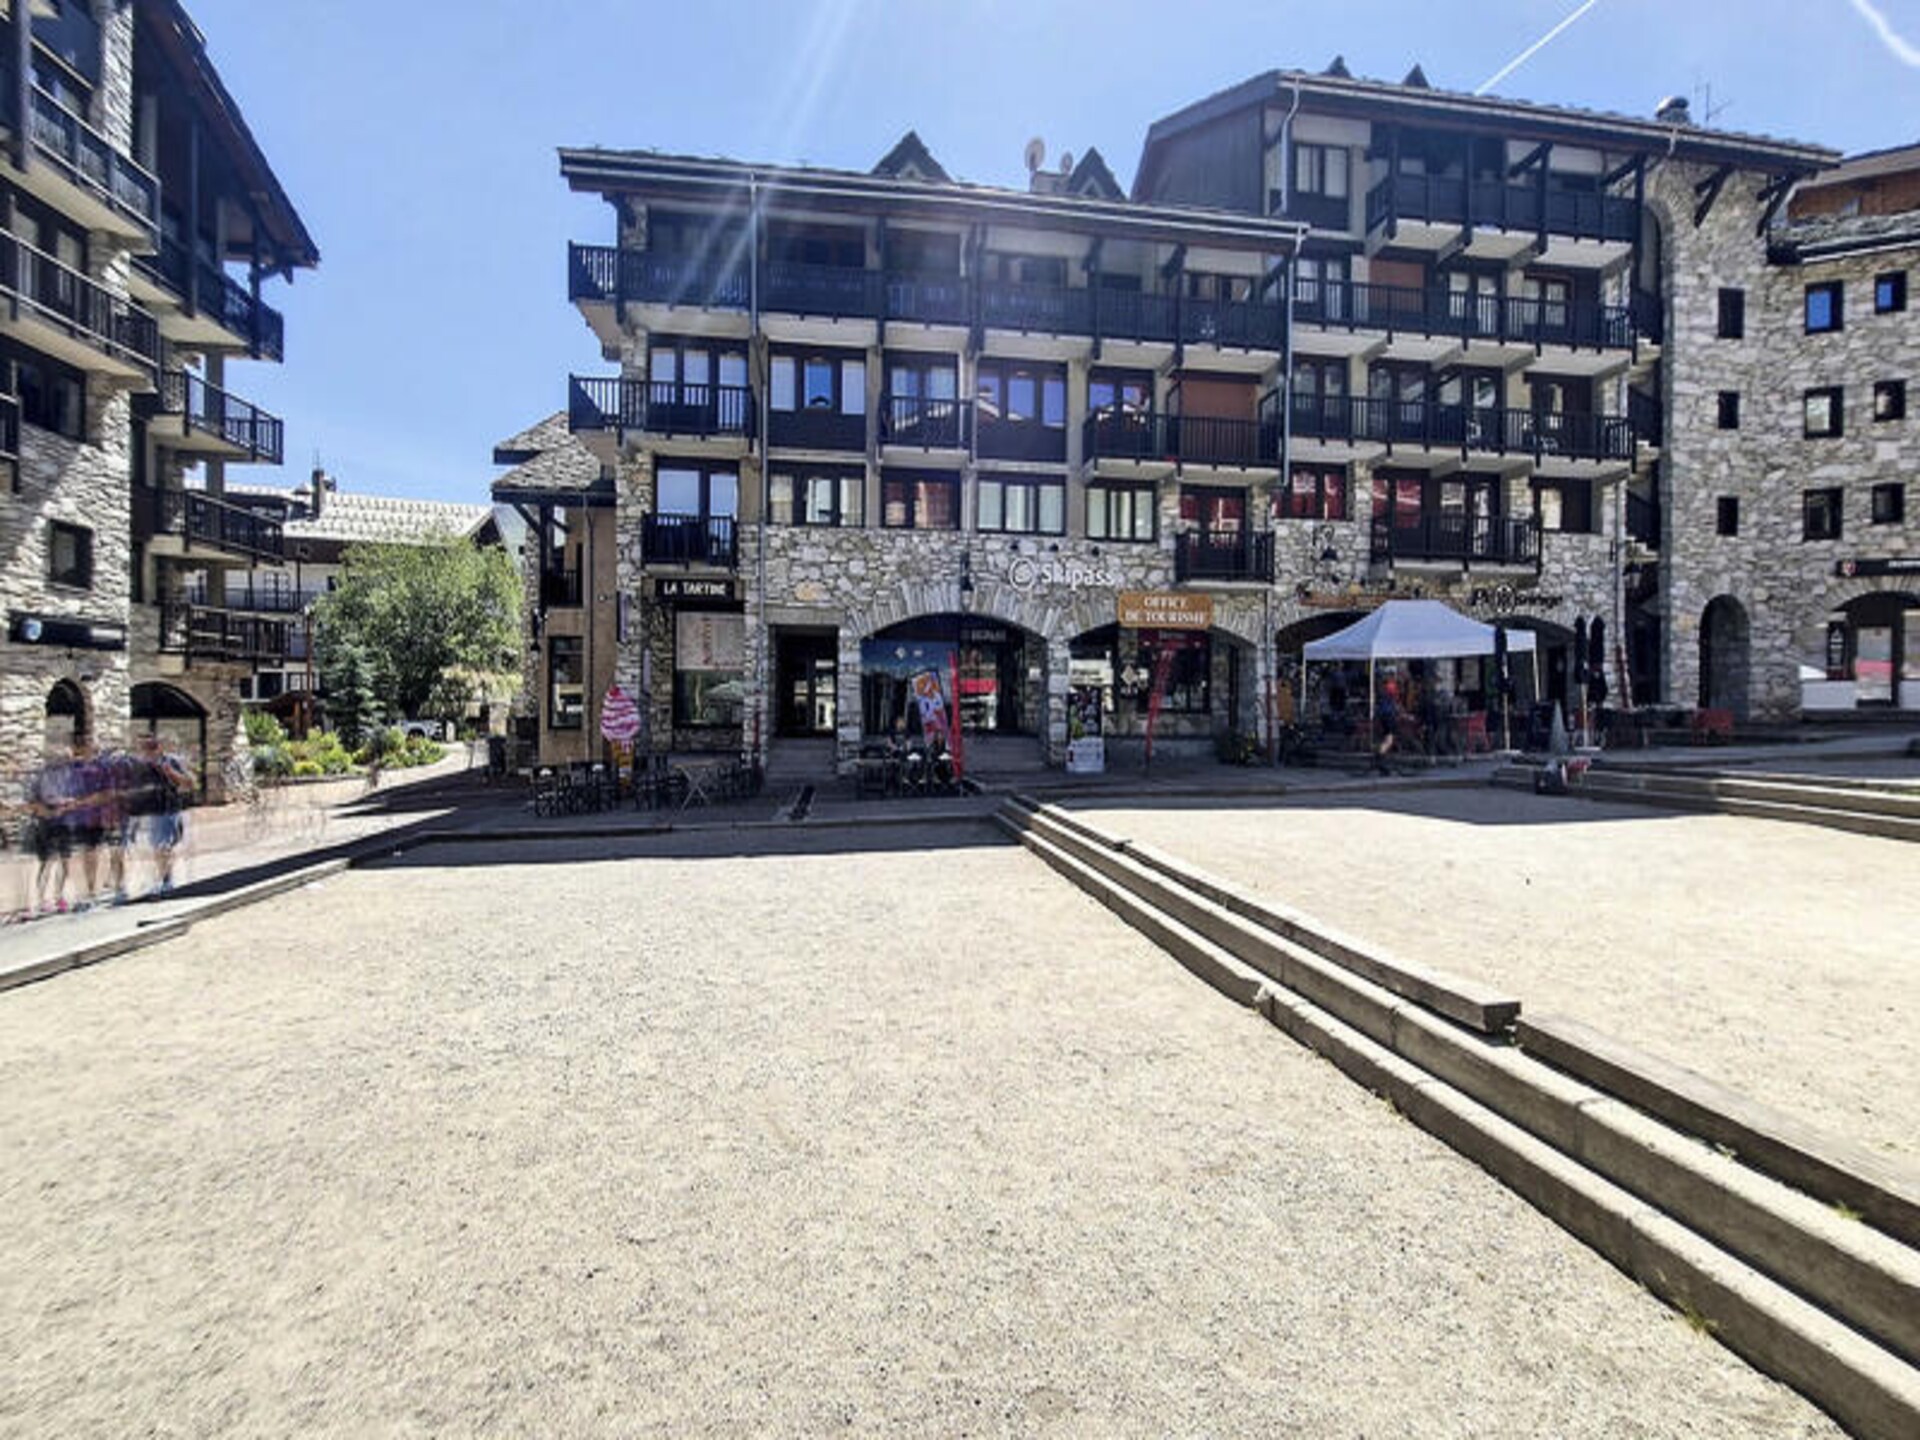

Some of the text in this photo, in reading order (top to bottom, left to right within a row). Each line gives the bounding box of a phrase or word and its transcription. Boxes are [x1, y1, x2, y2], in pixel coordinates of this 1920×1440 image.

[664, 581, 726, 596] LA TARTINE
[1143, 596, 1188, 610] OFFICE
[1145, 610, 1206, 624] TOURISME
